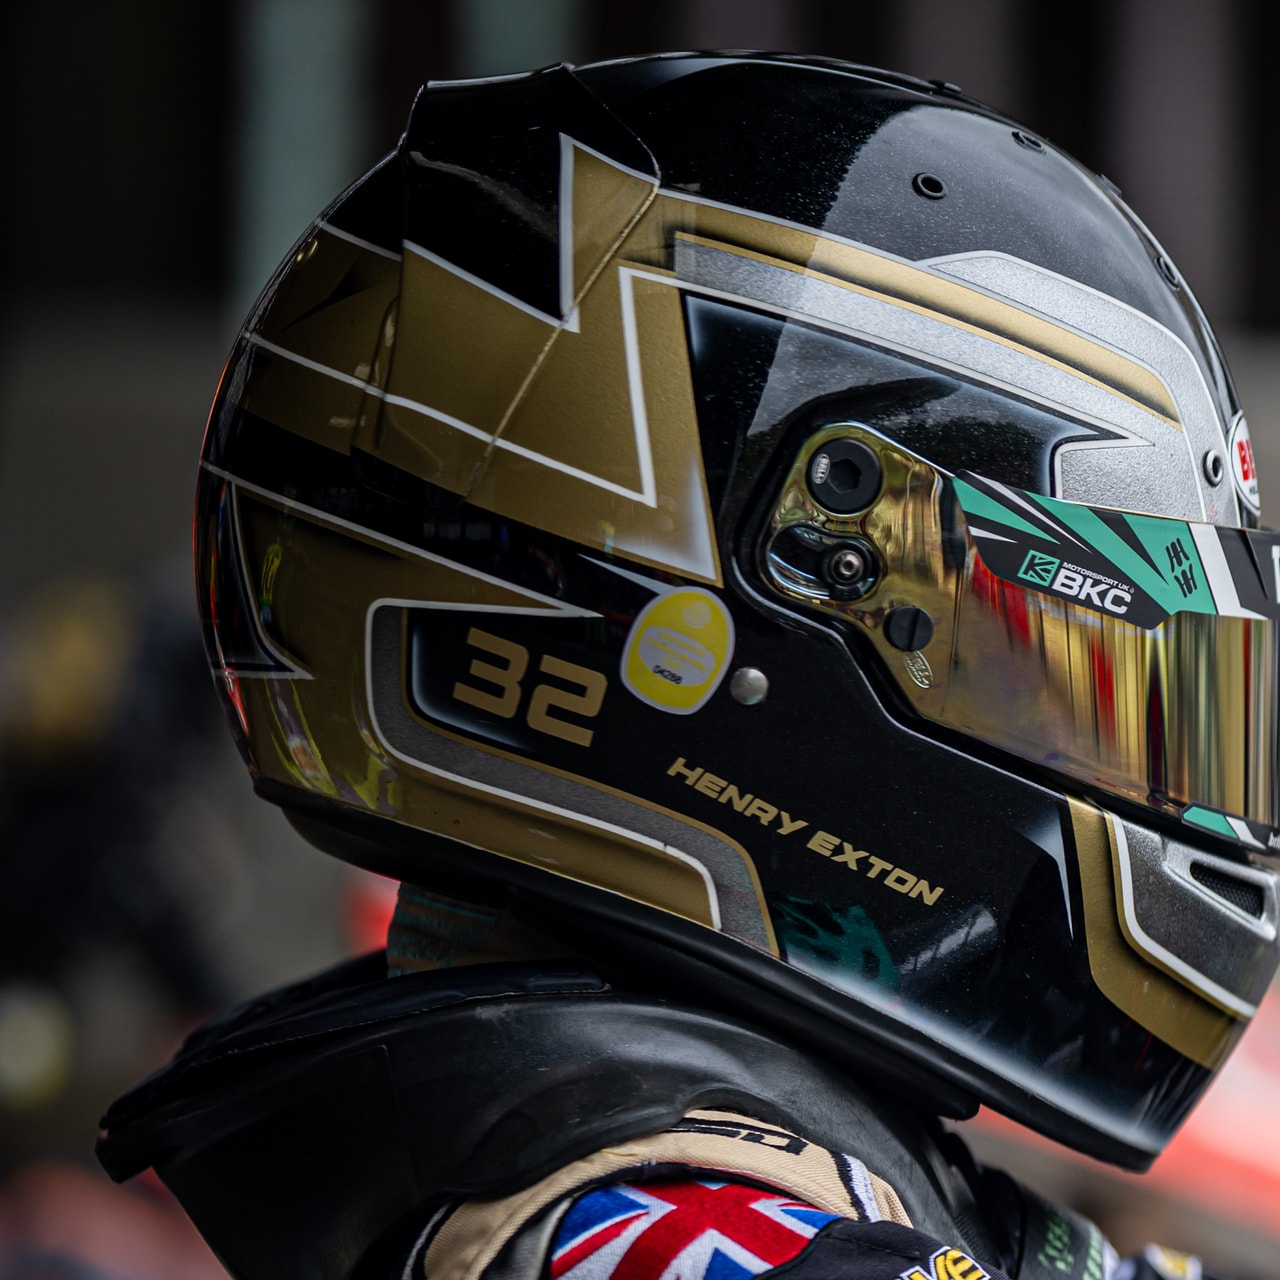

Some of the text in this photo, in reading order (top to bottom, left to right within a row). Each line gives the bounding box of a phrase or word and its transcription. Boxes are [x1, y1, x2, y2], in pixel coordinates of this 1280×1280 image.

[1051, 568, 1132, 615] BKC
[1062, 561, 1131, 593] MOTORSPORT UK
[453, 627, 608, 748] 32
[667, 757, 945, 906] HENRY EXTON
